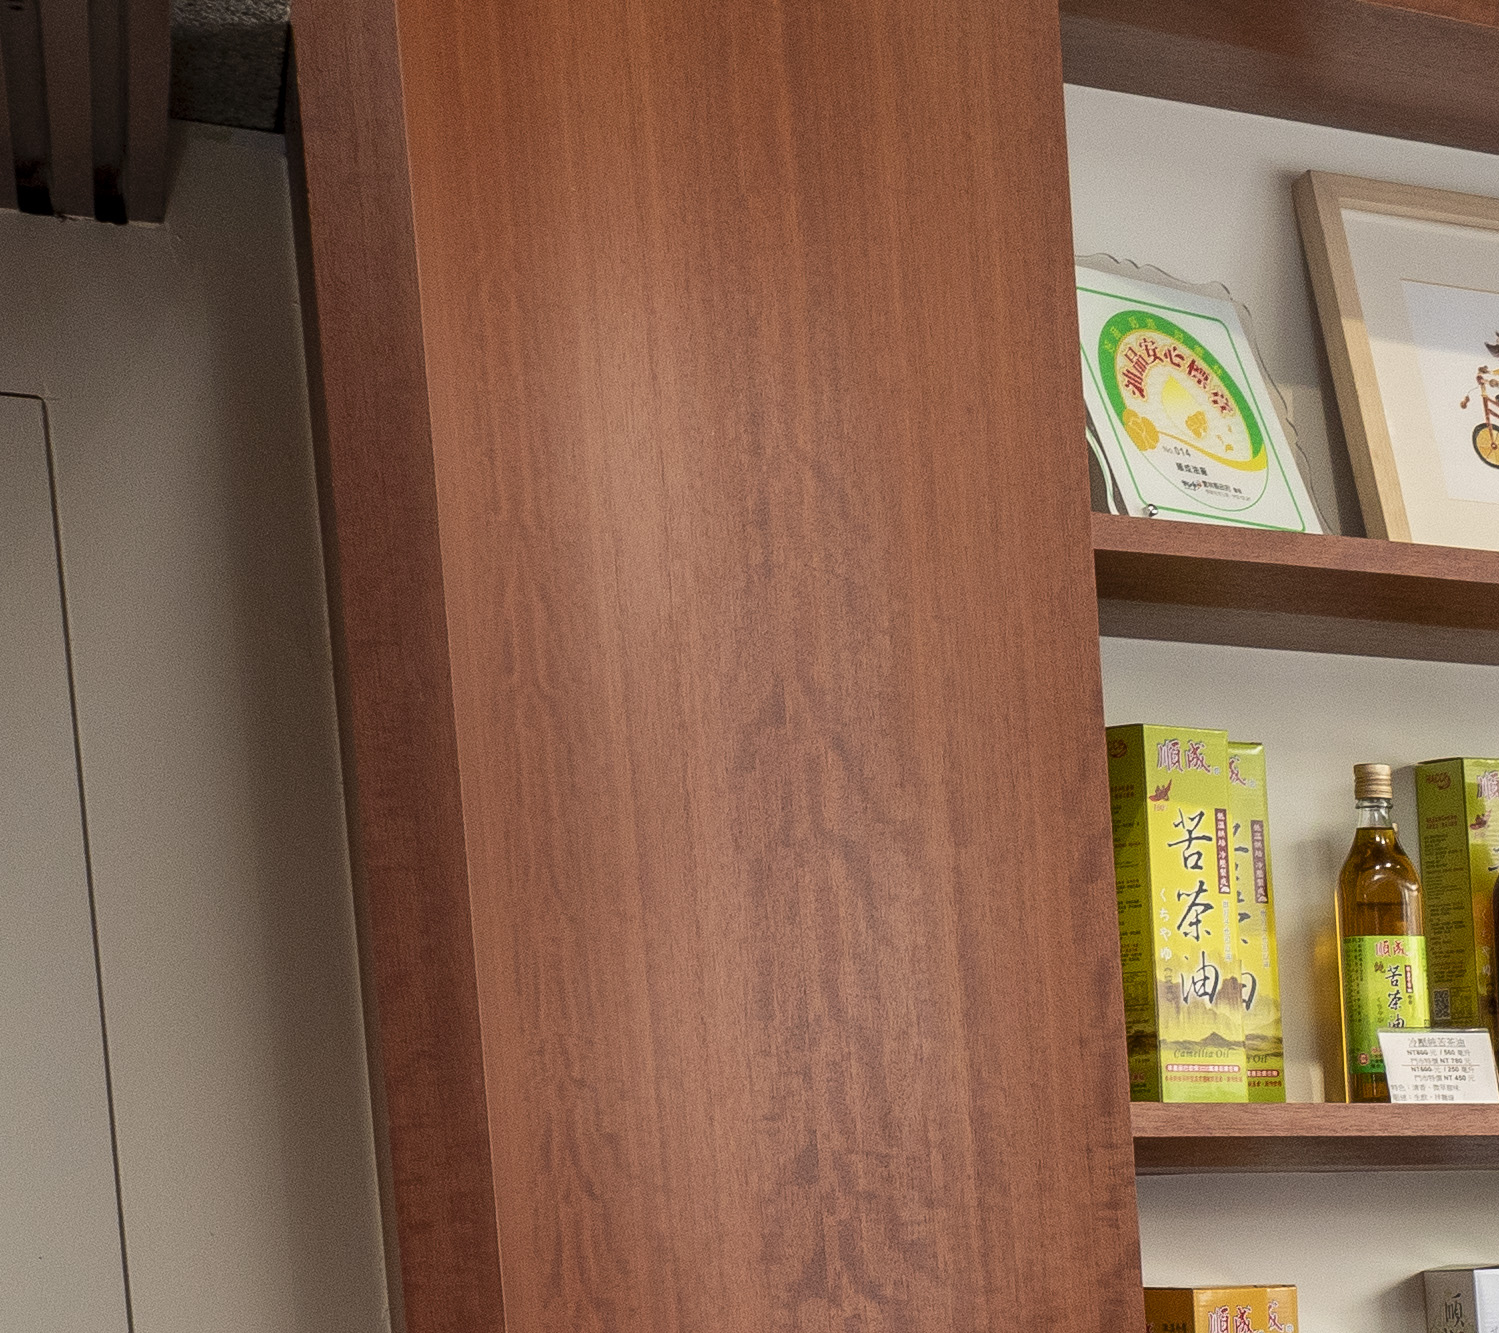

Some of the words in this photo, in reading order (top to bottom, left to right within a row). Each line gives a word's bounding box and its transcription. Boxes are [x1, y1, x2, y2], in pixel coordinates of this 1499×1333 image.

[1120, 336, 1236, 416] 油品安心標章
[1157, 738, 1212, 775] 順成
[1166, 807, 1220, 1005] 苦茶油
